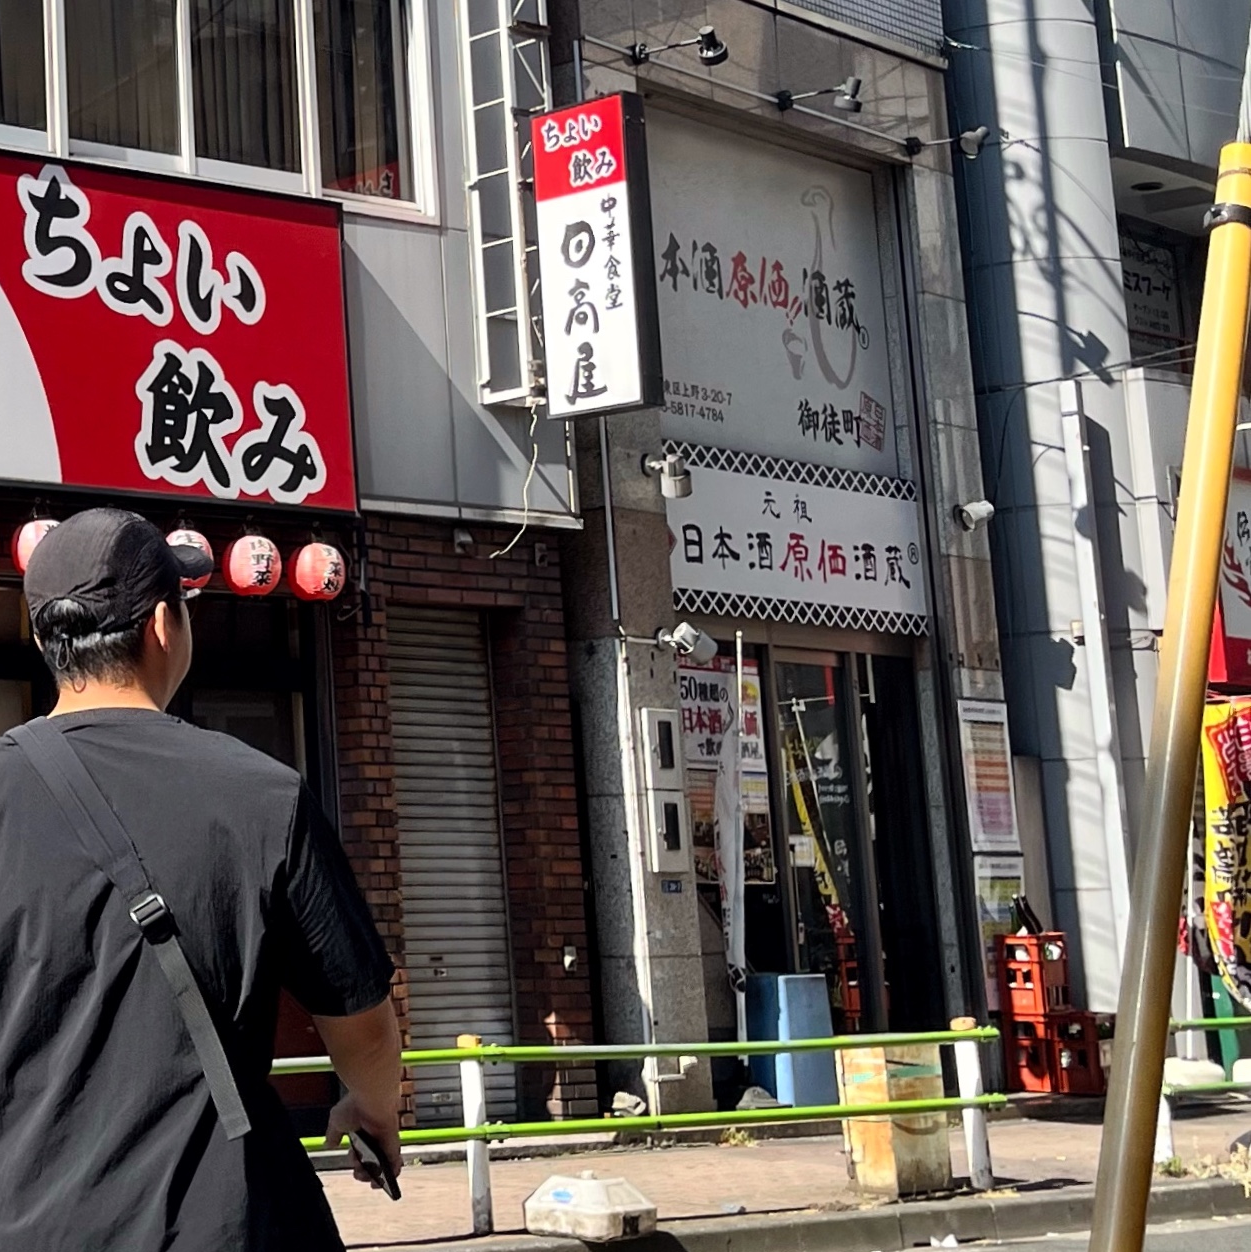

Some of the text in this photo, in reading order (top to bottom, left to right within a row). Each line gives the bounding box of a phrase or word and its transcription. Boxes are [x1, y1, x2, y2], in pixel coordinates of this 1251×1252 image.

[541, 113, 602, 151] ちょい
[569, 147, 616, 186] 飲み
[20, 166, 263, 333] ちょい
[600, 193, 623, 310] 中華食堂
[659, 232, 860, 335] 本酒原価酒蔵
[561, 220, 608, 406] 日高屋
[137, 343, 325, 501] 飲み
[798, 399, 861, 448] 御徒町
[761, 491, 812, 523] 元祖
